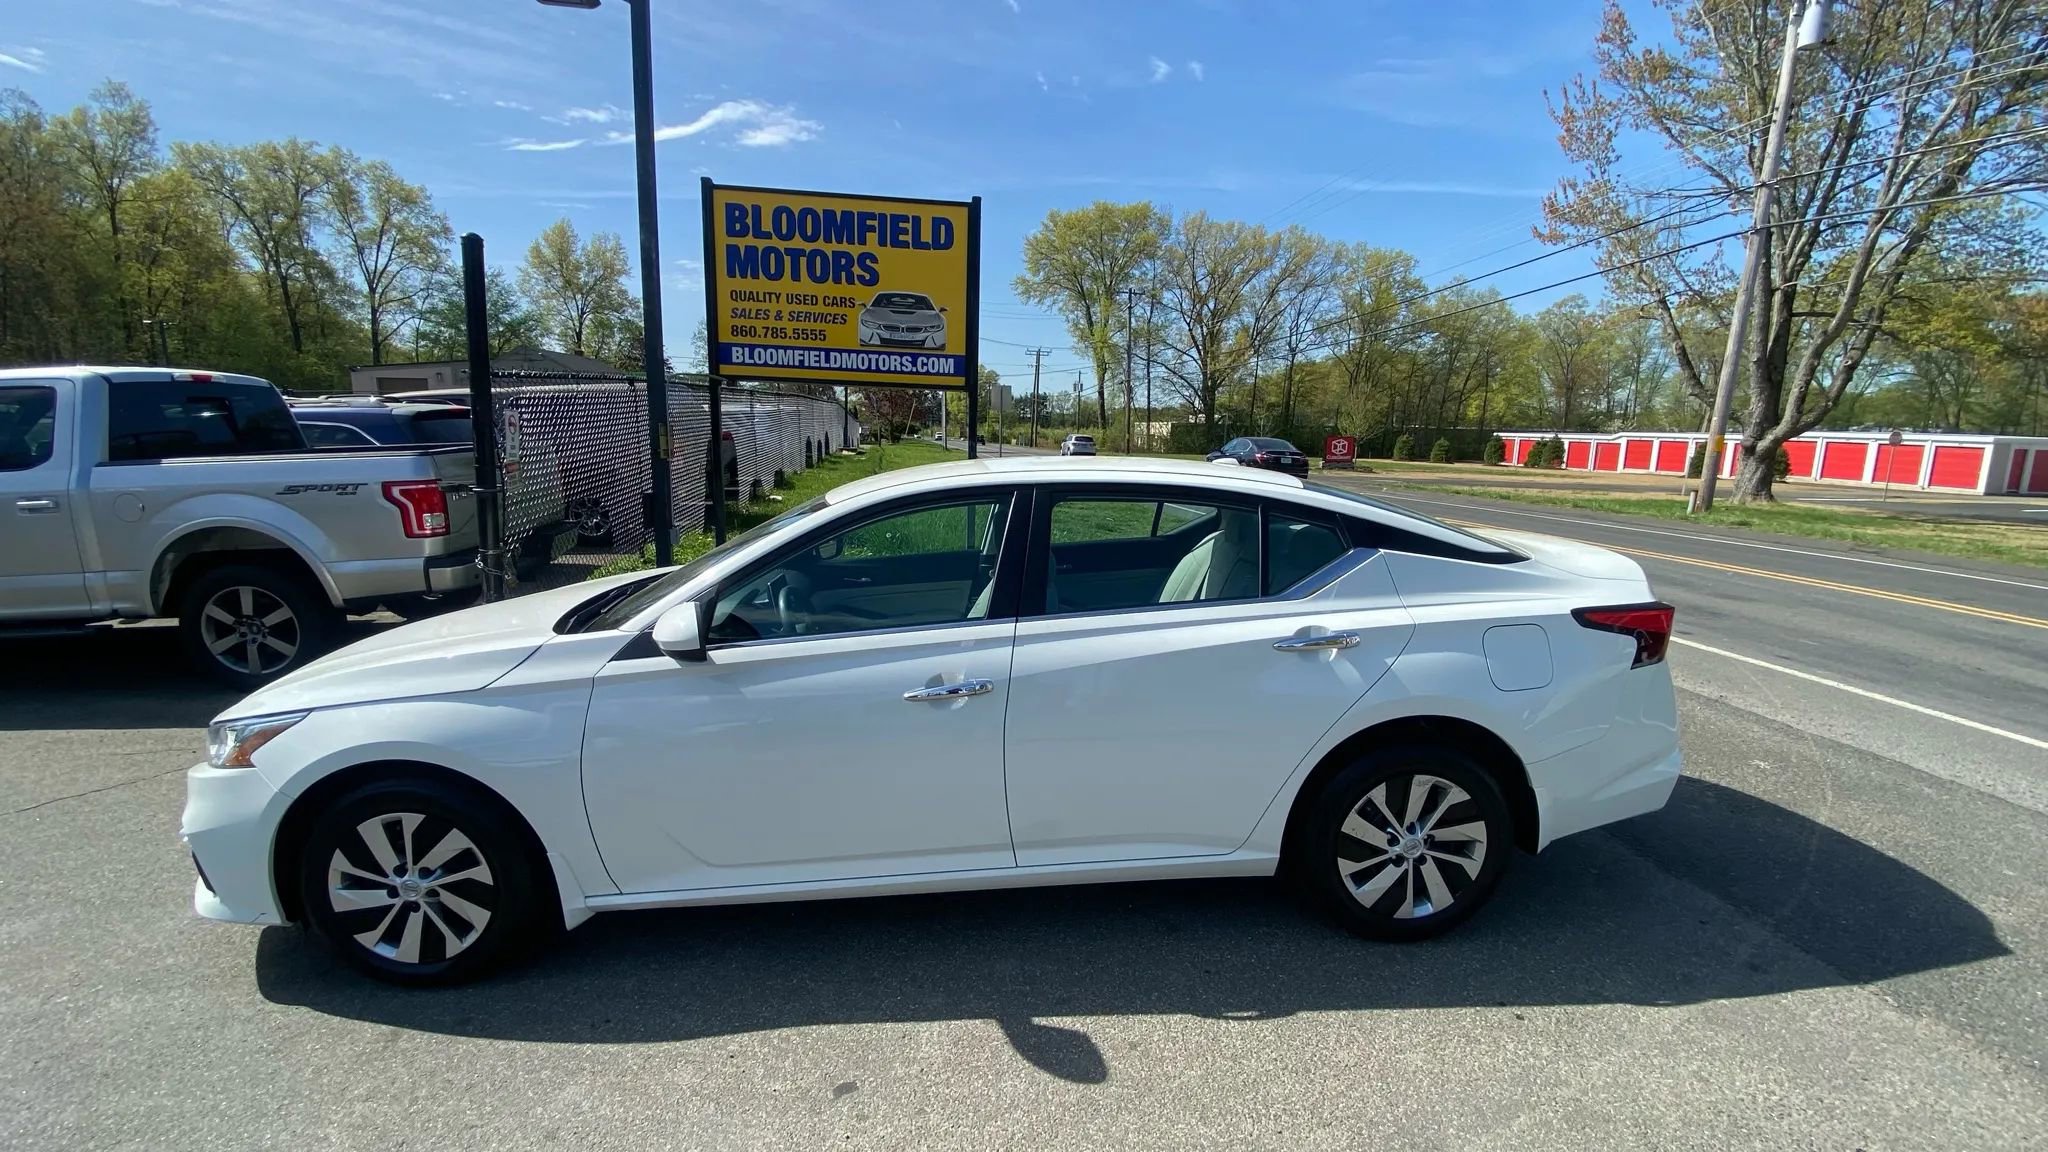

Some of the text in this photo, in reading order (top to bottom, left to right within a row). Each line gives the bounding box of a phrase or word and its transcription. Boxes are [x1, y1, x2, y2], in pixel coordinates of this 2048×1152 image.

[725, 203, 954, 250] BLOOMFIELD
[726, 244, 879, 286] MOTORS
[730, 289, 856, 309] QUALITY USED CARS
[730, 307, 848, 325] SALES & SERVICES
[730, 324, 827, 341] 860.785.5555
[731, 346, 954, 374] BLOOMFIELDMOTORS.COM
[275, 483, 368, 495] SPORT
